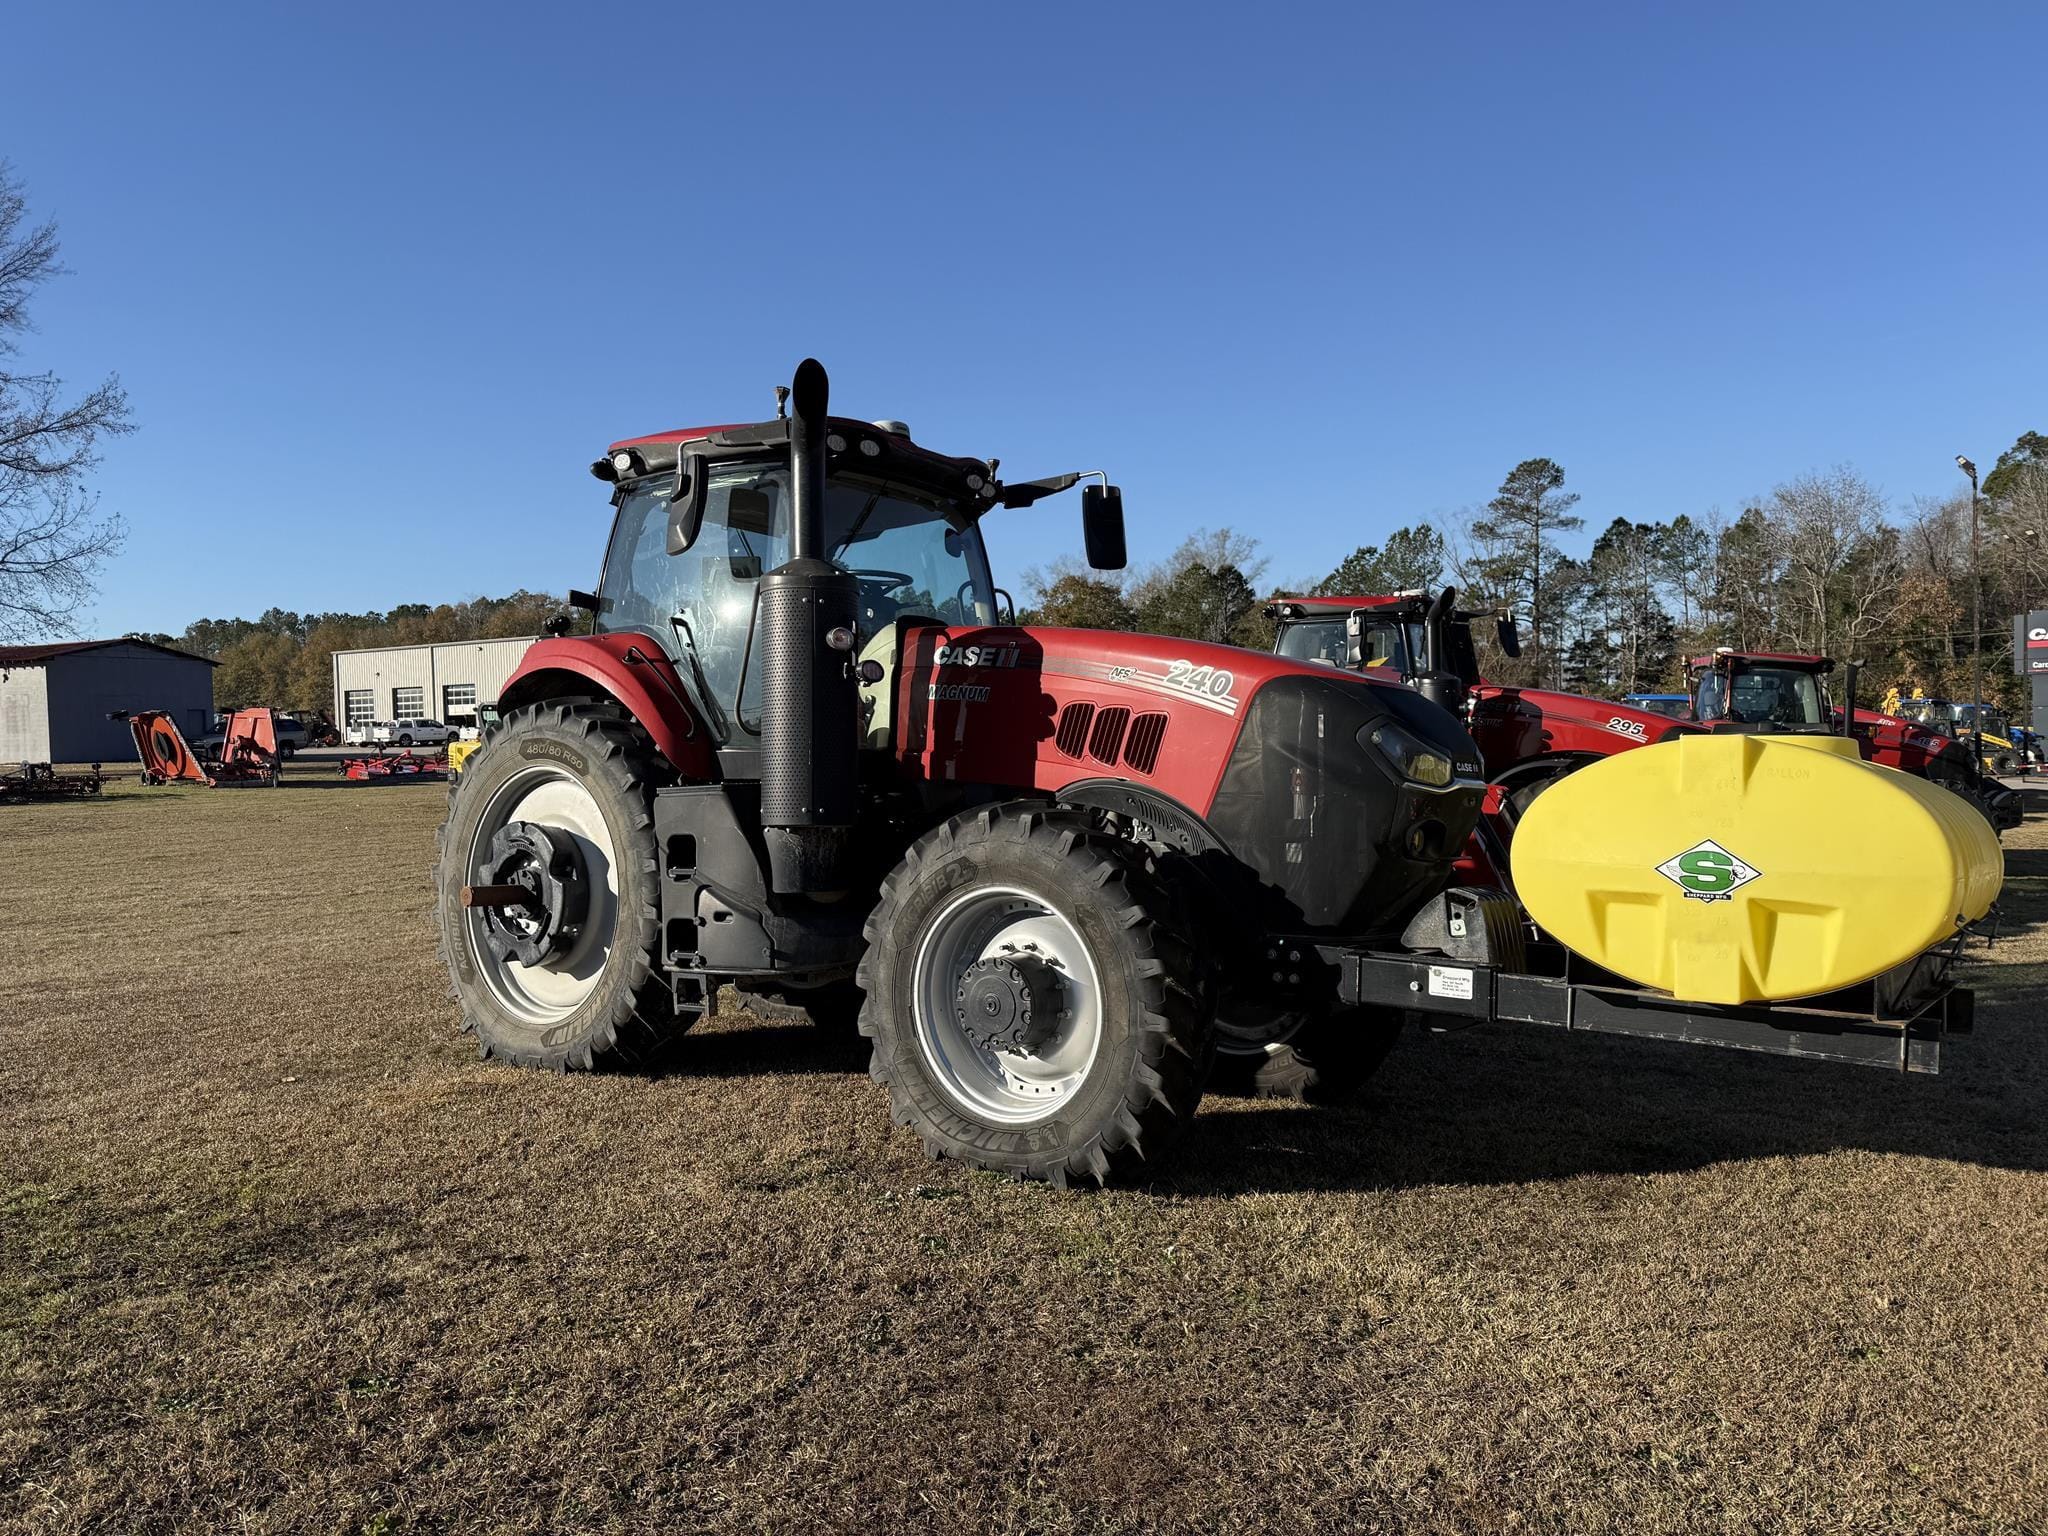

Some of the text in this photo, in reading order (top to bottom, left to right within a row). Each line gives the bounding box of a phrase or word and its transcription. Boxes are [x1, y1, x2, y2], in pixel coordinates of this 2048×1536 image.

[2029, 628, 2048, 641] C
[933, 646, 996, 667] CASE
[1110, 666, 1131, 678] AFS
[1163, 659, 1234, 699] 240
[927, 684, 991, 702] MAGNUM
[1606, 716, 1645, 736] 295
[526, 744, 584, 769] 480/80 R50
[1456, 762, 1473, 772] CASE
[1679, 850, 1735, 892] S
